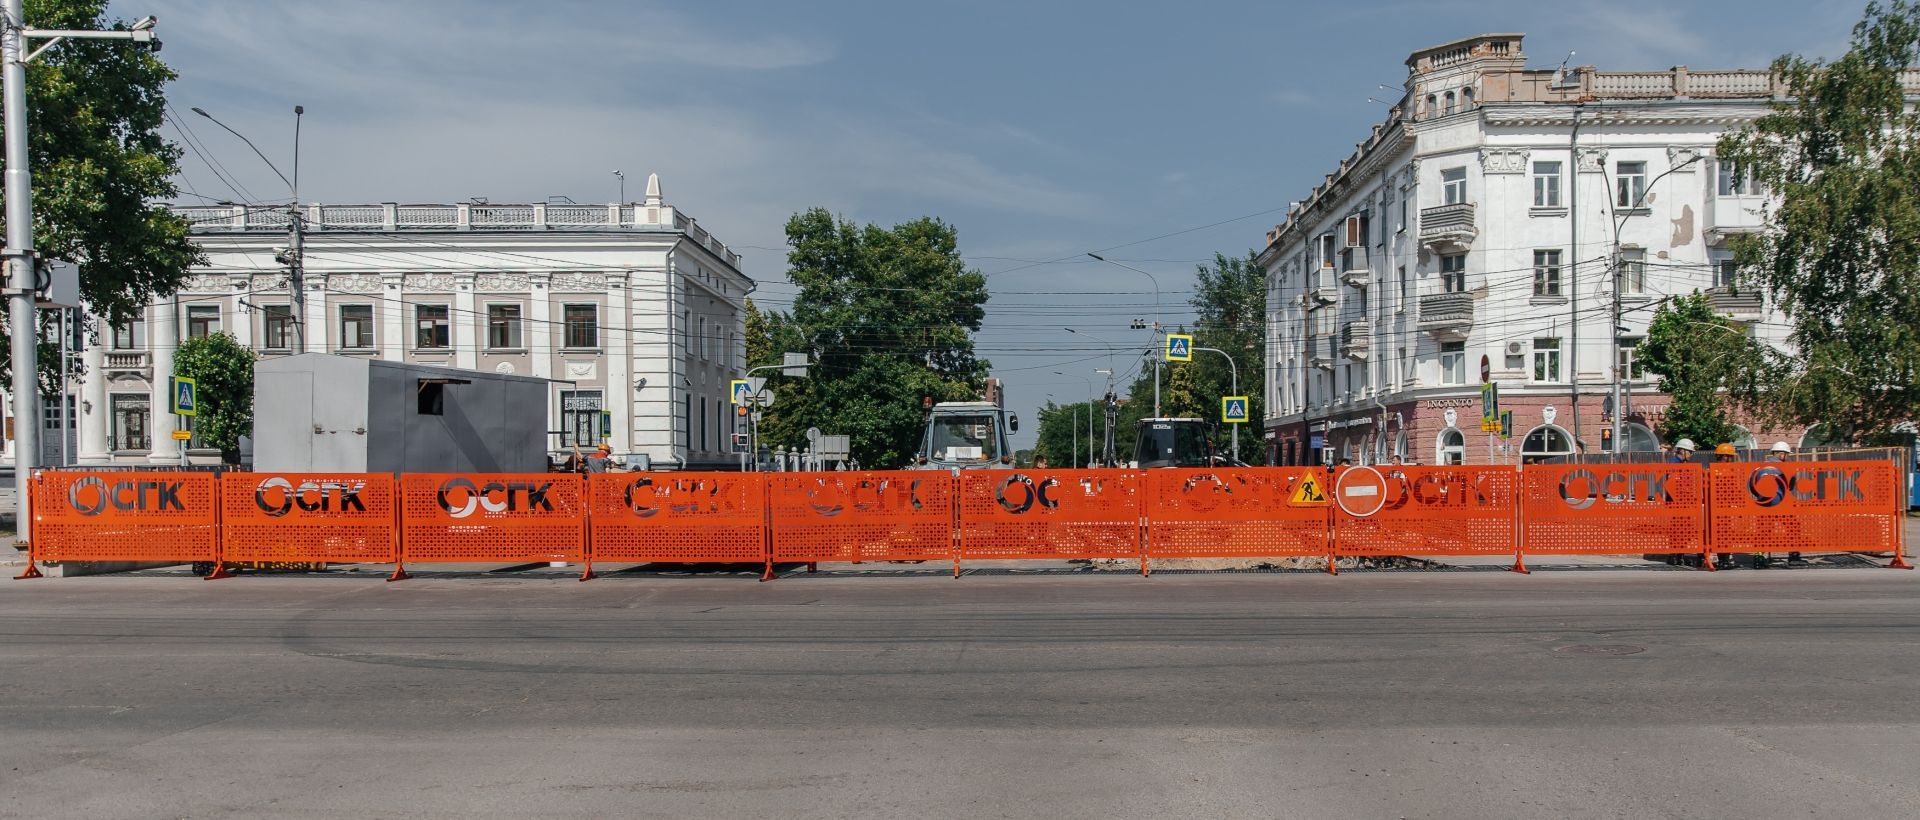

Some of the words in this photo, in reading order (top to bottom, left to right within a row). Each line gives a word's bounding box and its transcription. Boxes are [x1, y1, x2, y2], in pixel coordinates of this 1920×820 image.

[1427, 399, 1473, 409] INCANTO
[111, 480, 186, 511] СГК
[295, 481, 367, 512] СГК
[479, 482, 555, 512] СГК
